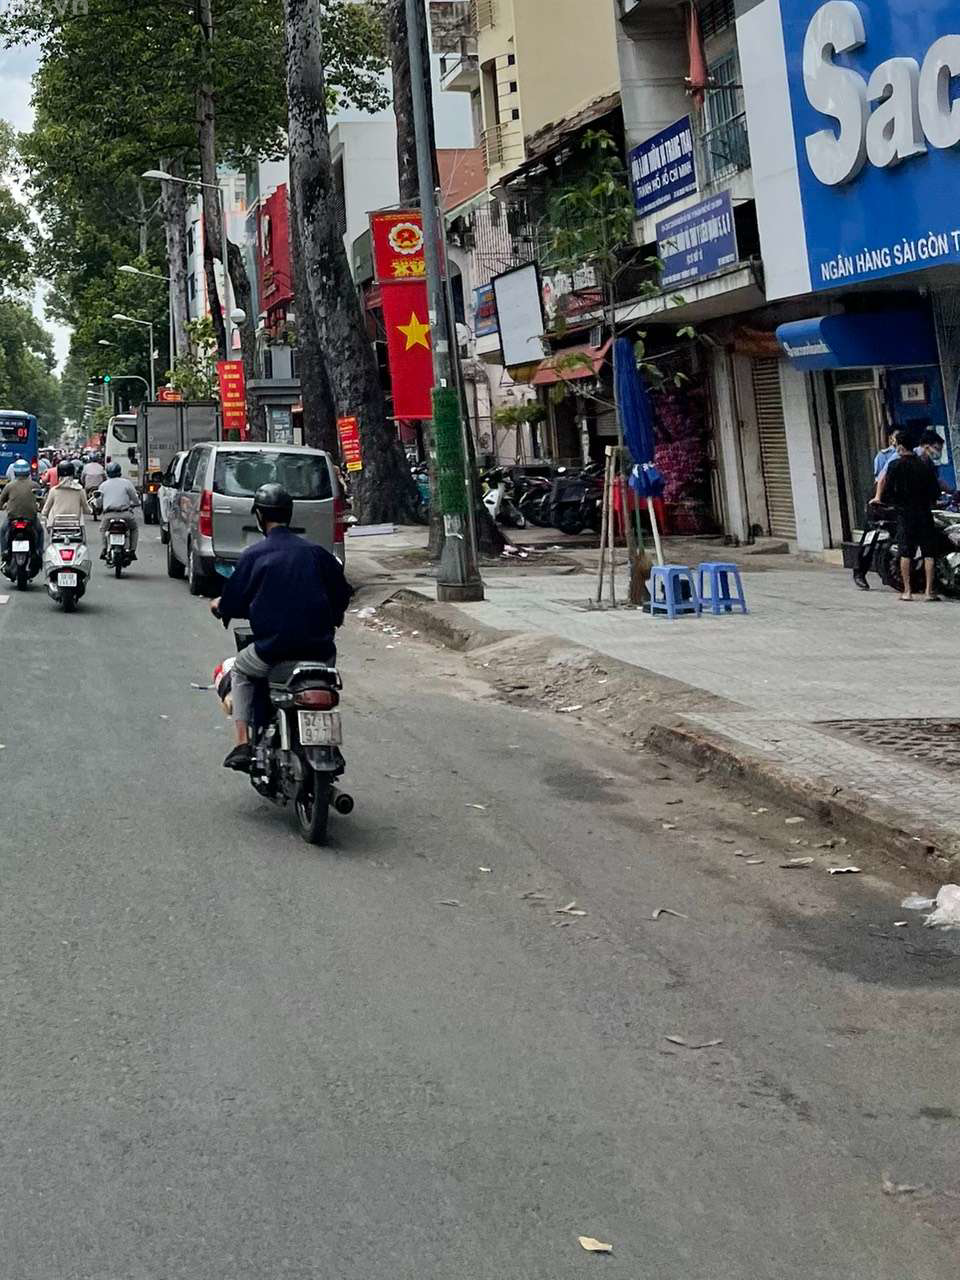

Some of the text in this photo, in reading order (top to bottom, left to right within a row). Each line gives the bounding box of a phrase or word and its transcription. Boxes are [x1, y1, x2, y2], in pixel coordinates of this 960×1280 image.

[803, 0, 960, 186] Sac
[821, 254, 854, 281] NGÂN
[856, 247, 892, 273] HÀNG
[893, 238, 916, 265] SÀI
[918, 231, 949, 260] GÒN
